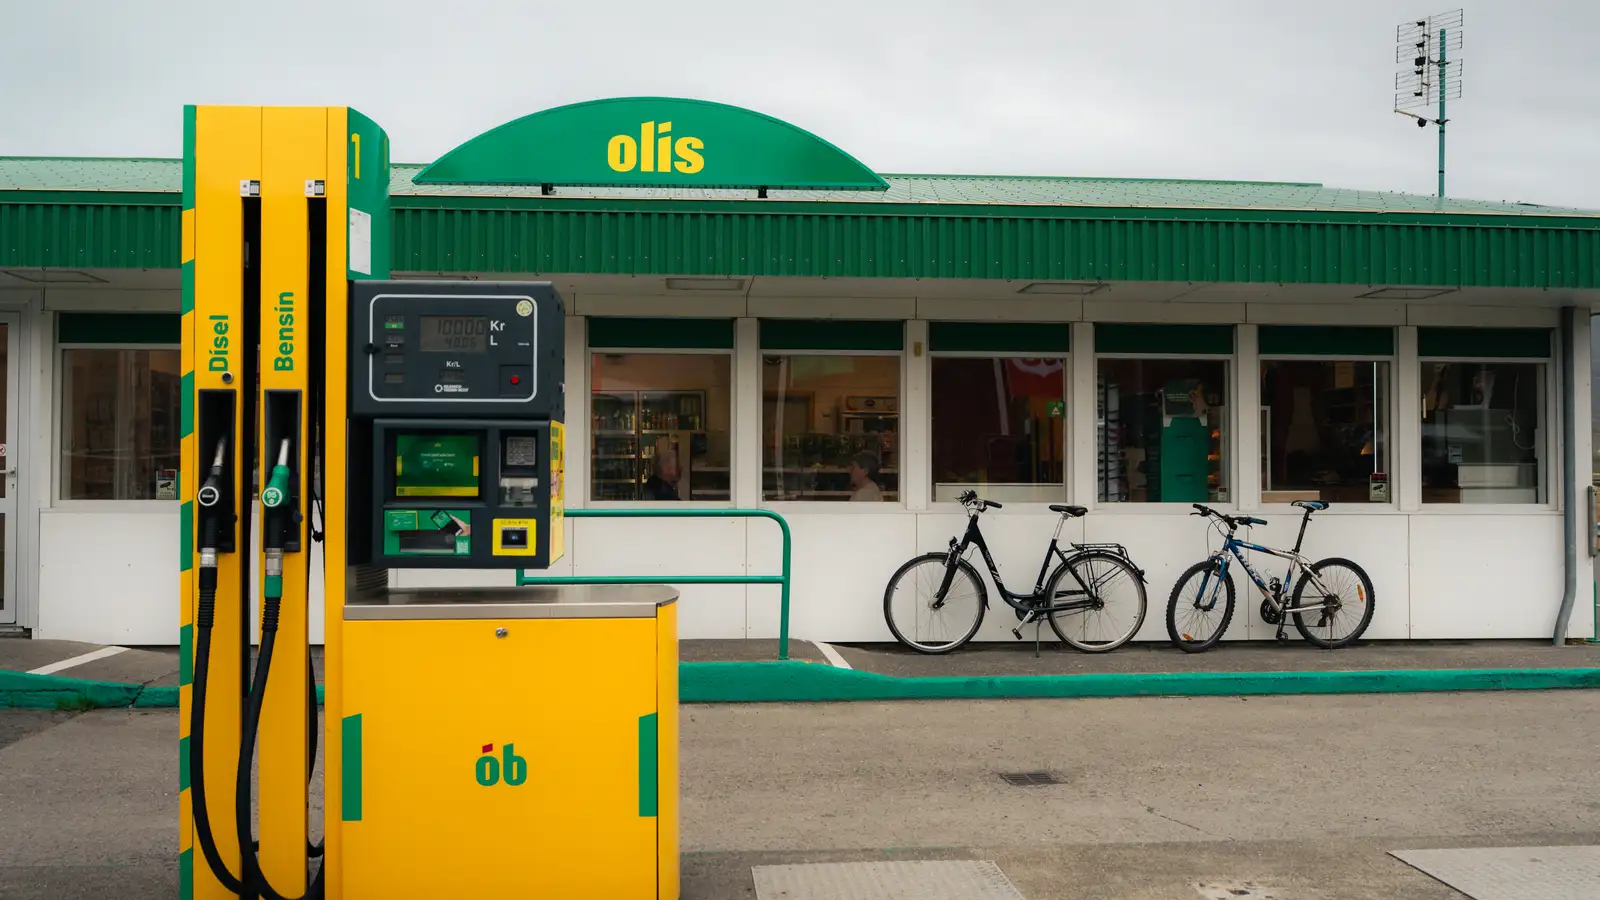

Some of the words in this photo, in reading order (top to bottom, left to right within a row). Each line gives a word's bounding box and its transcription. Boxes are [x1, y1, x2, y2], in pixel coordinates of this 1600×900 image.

[351, 132, 360, 180] 1
[607, 120, 705, 174] olis
[208, 315, 229, 372] Dísel
[274, 292, 294, 371] Bensín
[490, 320, 506, 331] Kr
[490, 335, 498, 346] L
[266, 491, 277, 499] 95
[475, 743, 528, 787] ób
